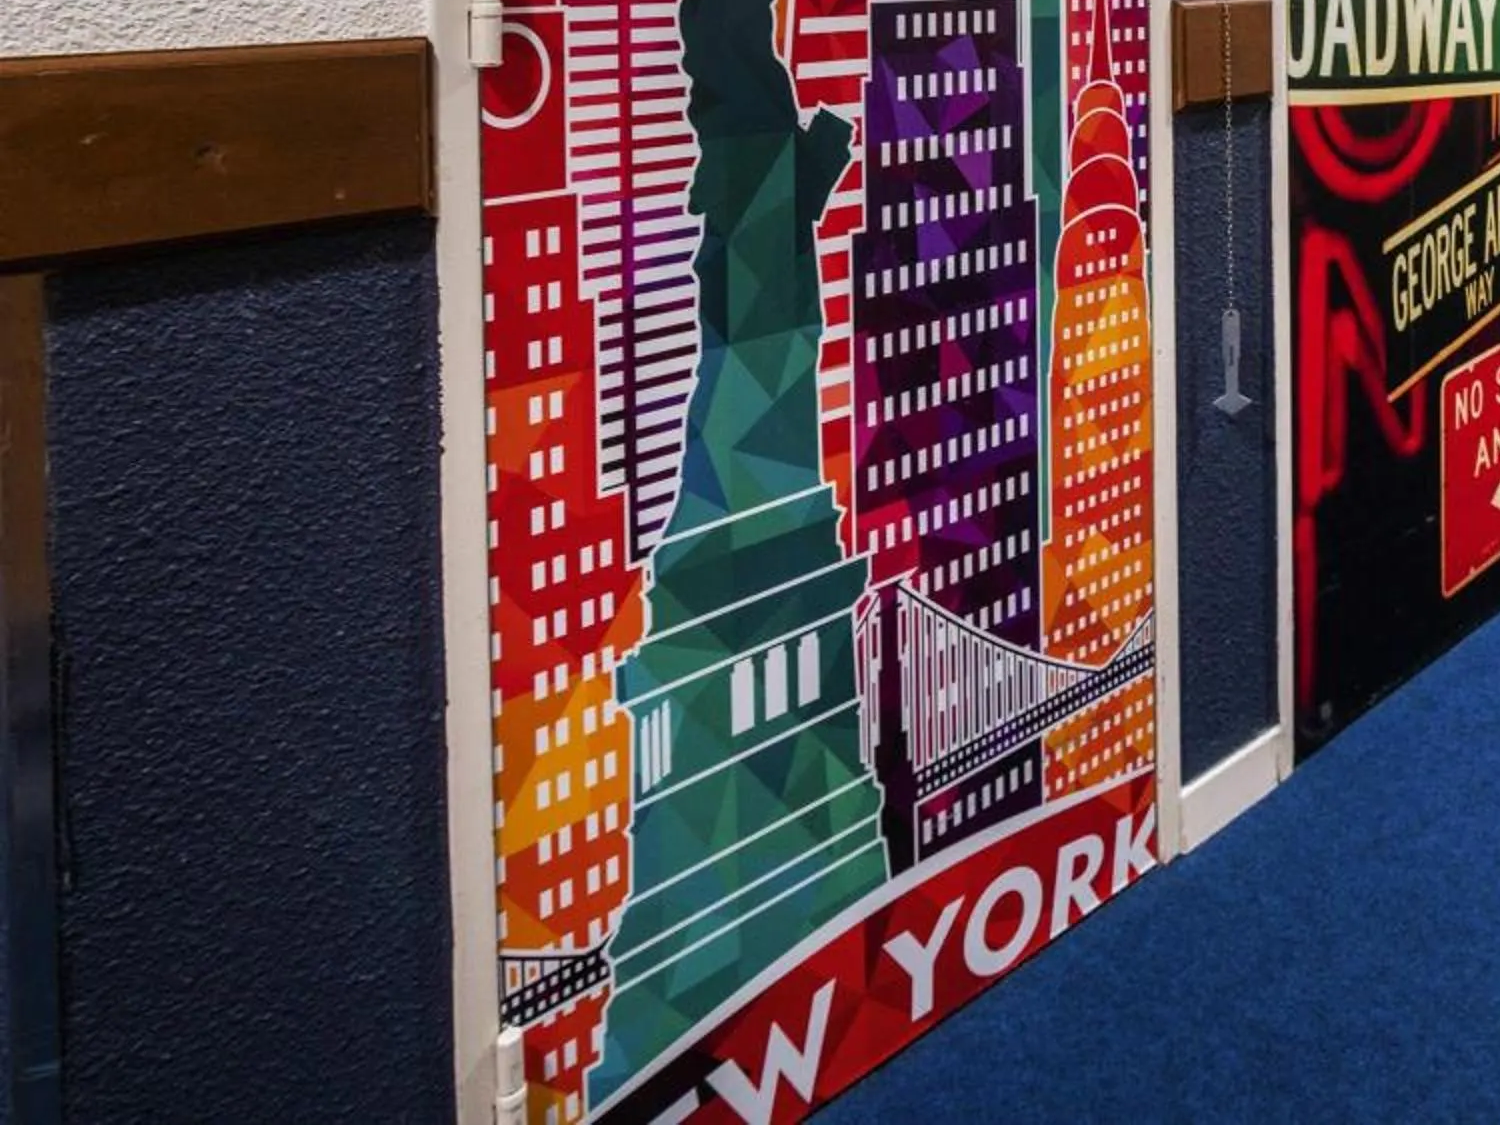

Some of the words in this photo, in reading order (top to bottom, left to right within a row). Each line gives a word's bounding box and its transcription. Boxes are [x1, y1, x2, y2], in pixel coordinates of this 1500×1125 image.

[1392, 203, 1477, 332] GEORGE
[1465, 266, 1495, 321] WAY
[1454, 381, 1484, 431] NO
[650, 978, 836, 1125] W
[883, 803, 1156, 1022] YORK
